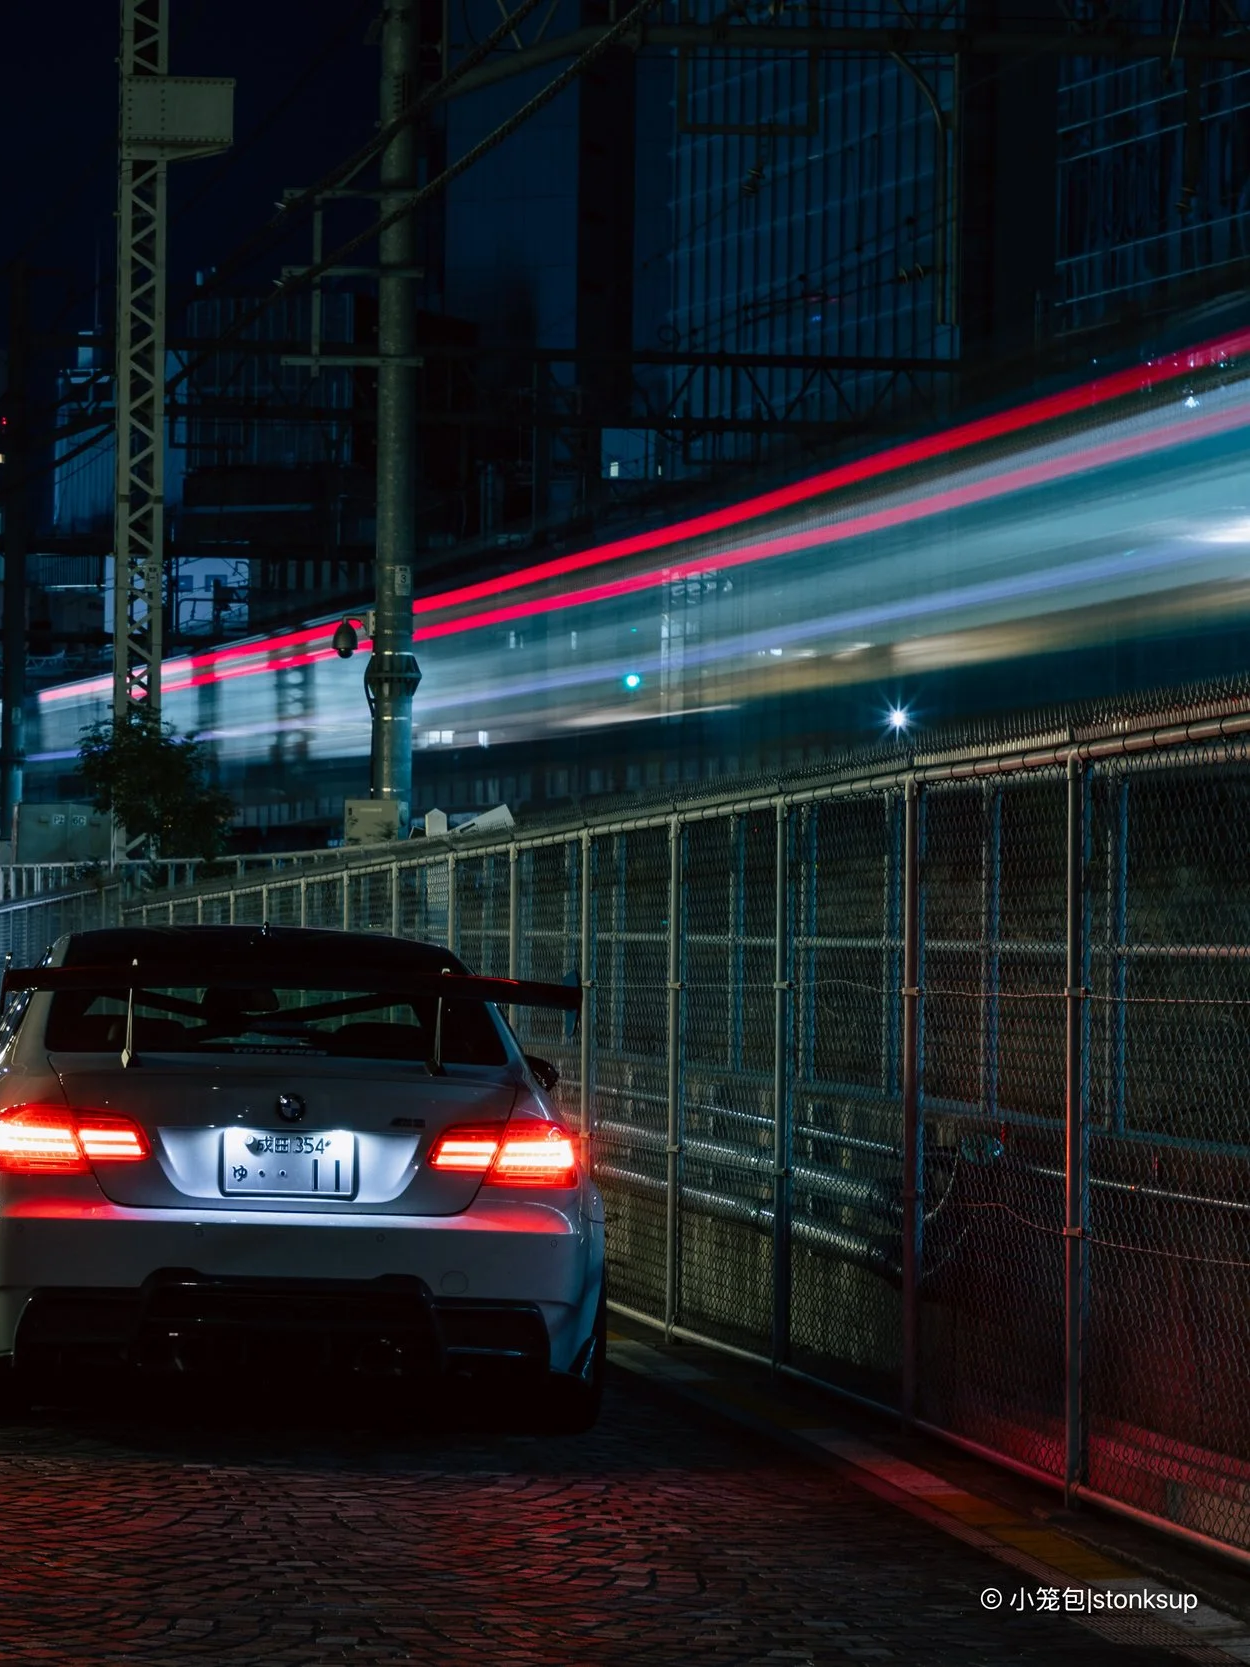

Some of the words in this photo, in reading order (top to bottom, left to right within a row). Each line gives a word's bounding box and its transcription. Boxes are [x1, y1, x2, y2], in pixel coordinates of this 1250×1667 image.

[256, 1136, 290, 1154] 成田
[293, 1136, 326, 1154] 354
[232, 1165, 248, 1182] ゆ
